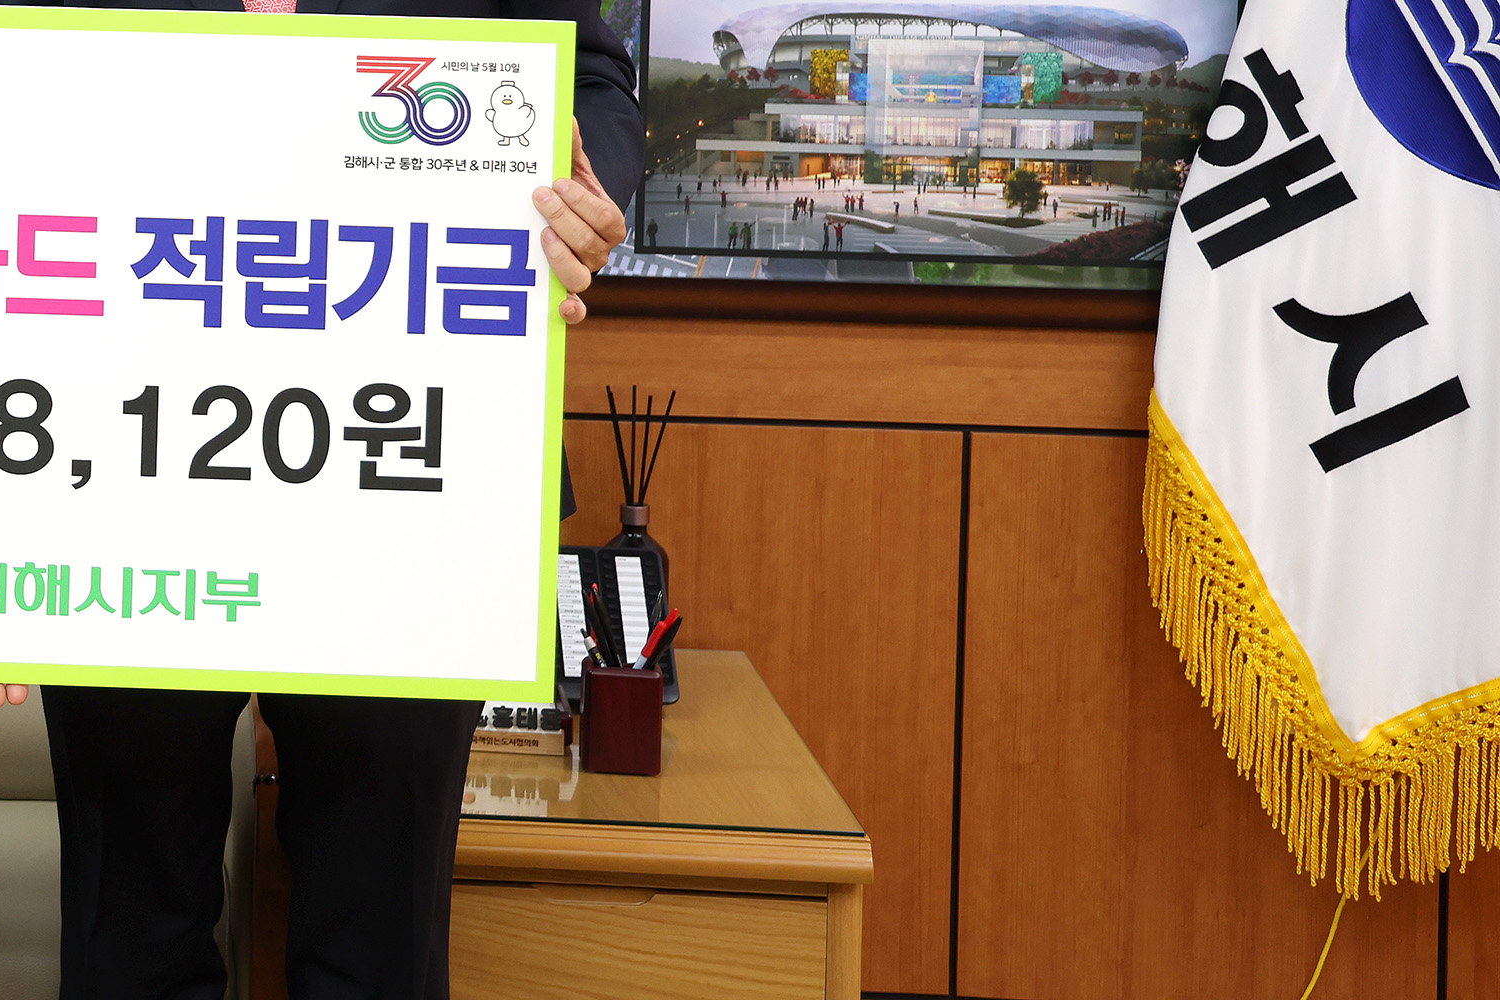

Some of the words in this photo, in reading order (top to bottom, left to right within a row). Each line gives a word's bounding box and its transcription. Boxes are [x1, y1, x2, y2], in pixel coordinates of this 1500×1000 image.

[440, 60, 470, 73] 시민의
[470, 61, 480, 73] 날
[481, 62, 497, 73] 5월
[499, 62, 521, 74] 10일
[399, 157, 423, 171] 통합
[426, 158, 467, 172] 30주년
[469, 160, 480, 172] &
[482, 159, 506, 174] 미래
[509, 160, 538, 175] 30년
[129, 215, 537, 337] 적립기금
